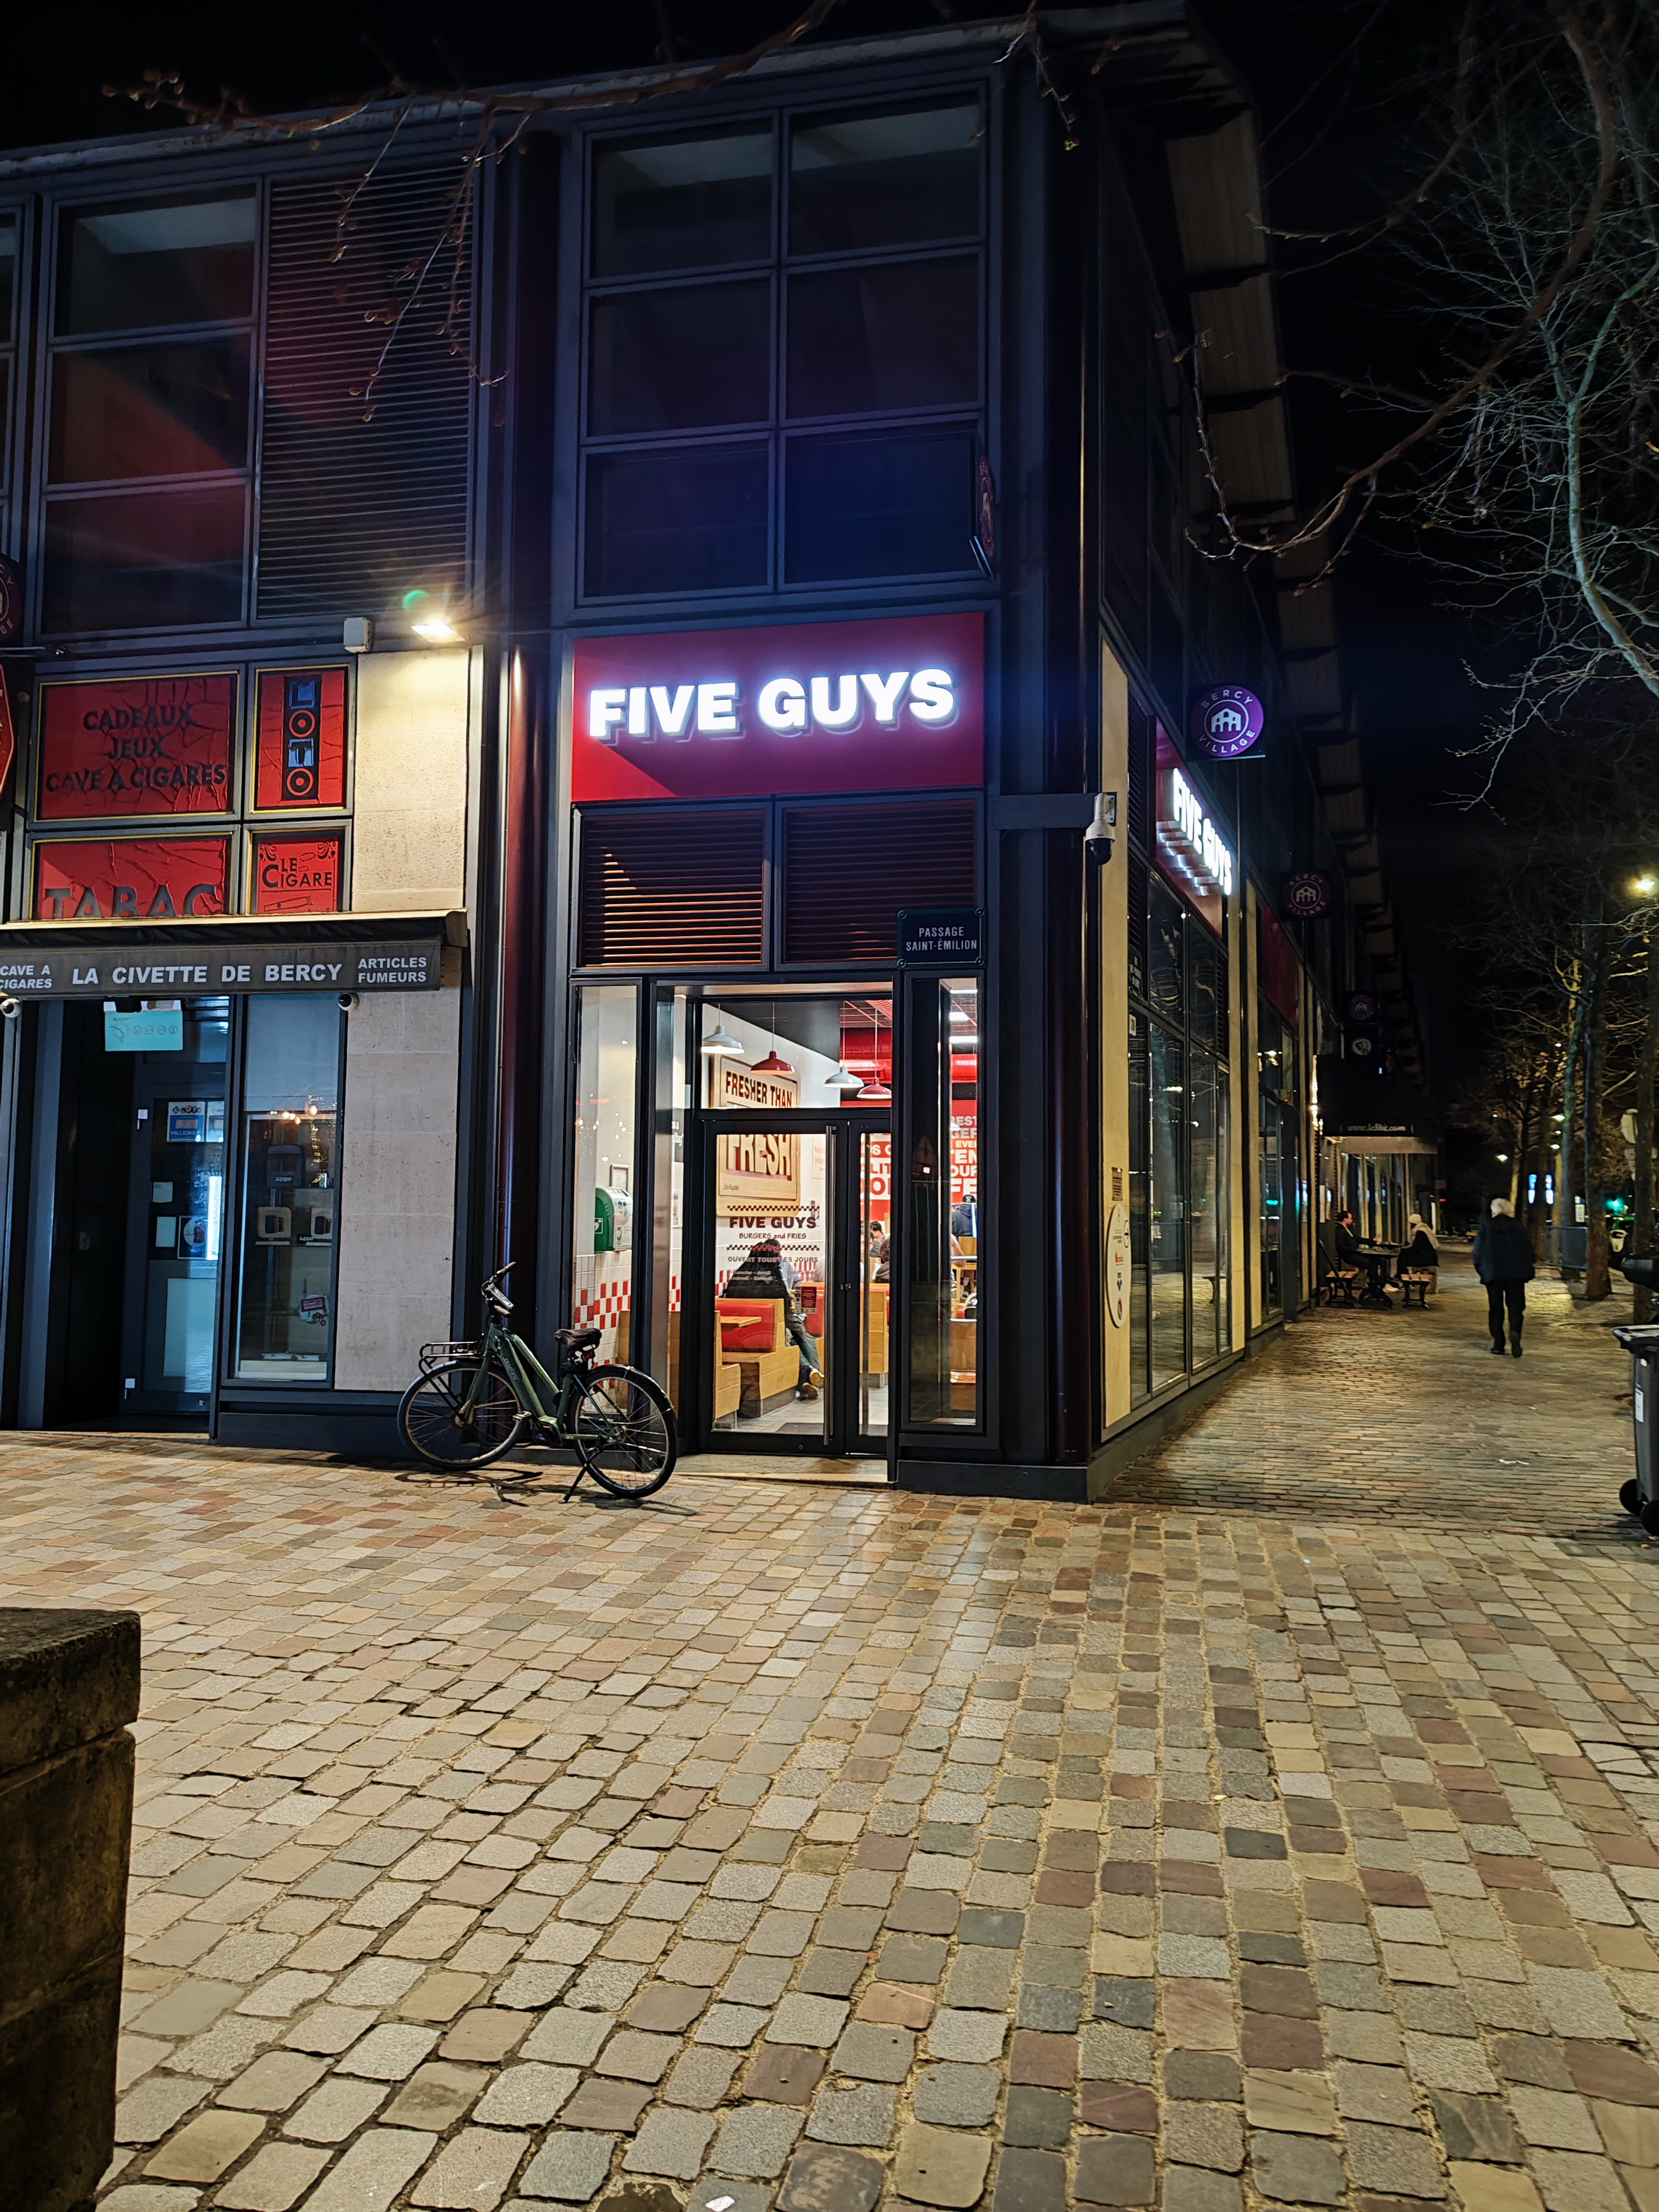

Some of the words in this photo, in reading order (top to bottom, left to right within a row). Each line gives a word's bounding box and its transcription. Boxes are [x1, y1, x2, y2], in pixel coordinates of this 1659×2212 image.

[589, 682, 739, 739] FIVE
[759, 669, 955, 729] GUYS
[1201, 690, 1253, 709] BERCY
[83, 705, 192, 730] CADEAUX
[109, 737, 166, 759] JEUX
[287, 680, 316, 797] LOTO
[1199, 730, 1256, 753] VILLAGE
[46, 770, 103, 792] CAVE
[130, 765, 226, 788] CIGARES
[1173, 768, 1202, 854] FIVE
[1203, 818, 1232, 895] GUYS
[281, 858, 298, 872] LE
[262, 865, 332, 887] CIGARE
[45, 884, 220, 918] TABAC
[919, 927, 965, 938] PASSAGE
[906, 939, 977, 951] SAINT-ÉMILION
[0, 965, 34, 976] CAVE
[41, 965, 51, 975] A
[358, 956, 427, 969] ARTICLES
[0, 978, 52, 989] CIGARES
[72, 968, 99, 984] LA
[112, 966, 207, 983] CIVETTE
[221, 965, 251, 982] DE
[265, 963, 342, 982] BERCY
[358, 972, 427, 983] FUMEURS
[726, 1071, 767, 1104] FRESHER
[770, 1085, 792, 1108] THAN
[730, 1217, 766, 1228] FIVE
[771, 1217, 817, 1229] GUYS
